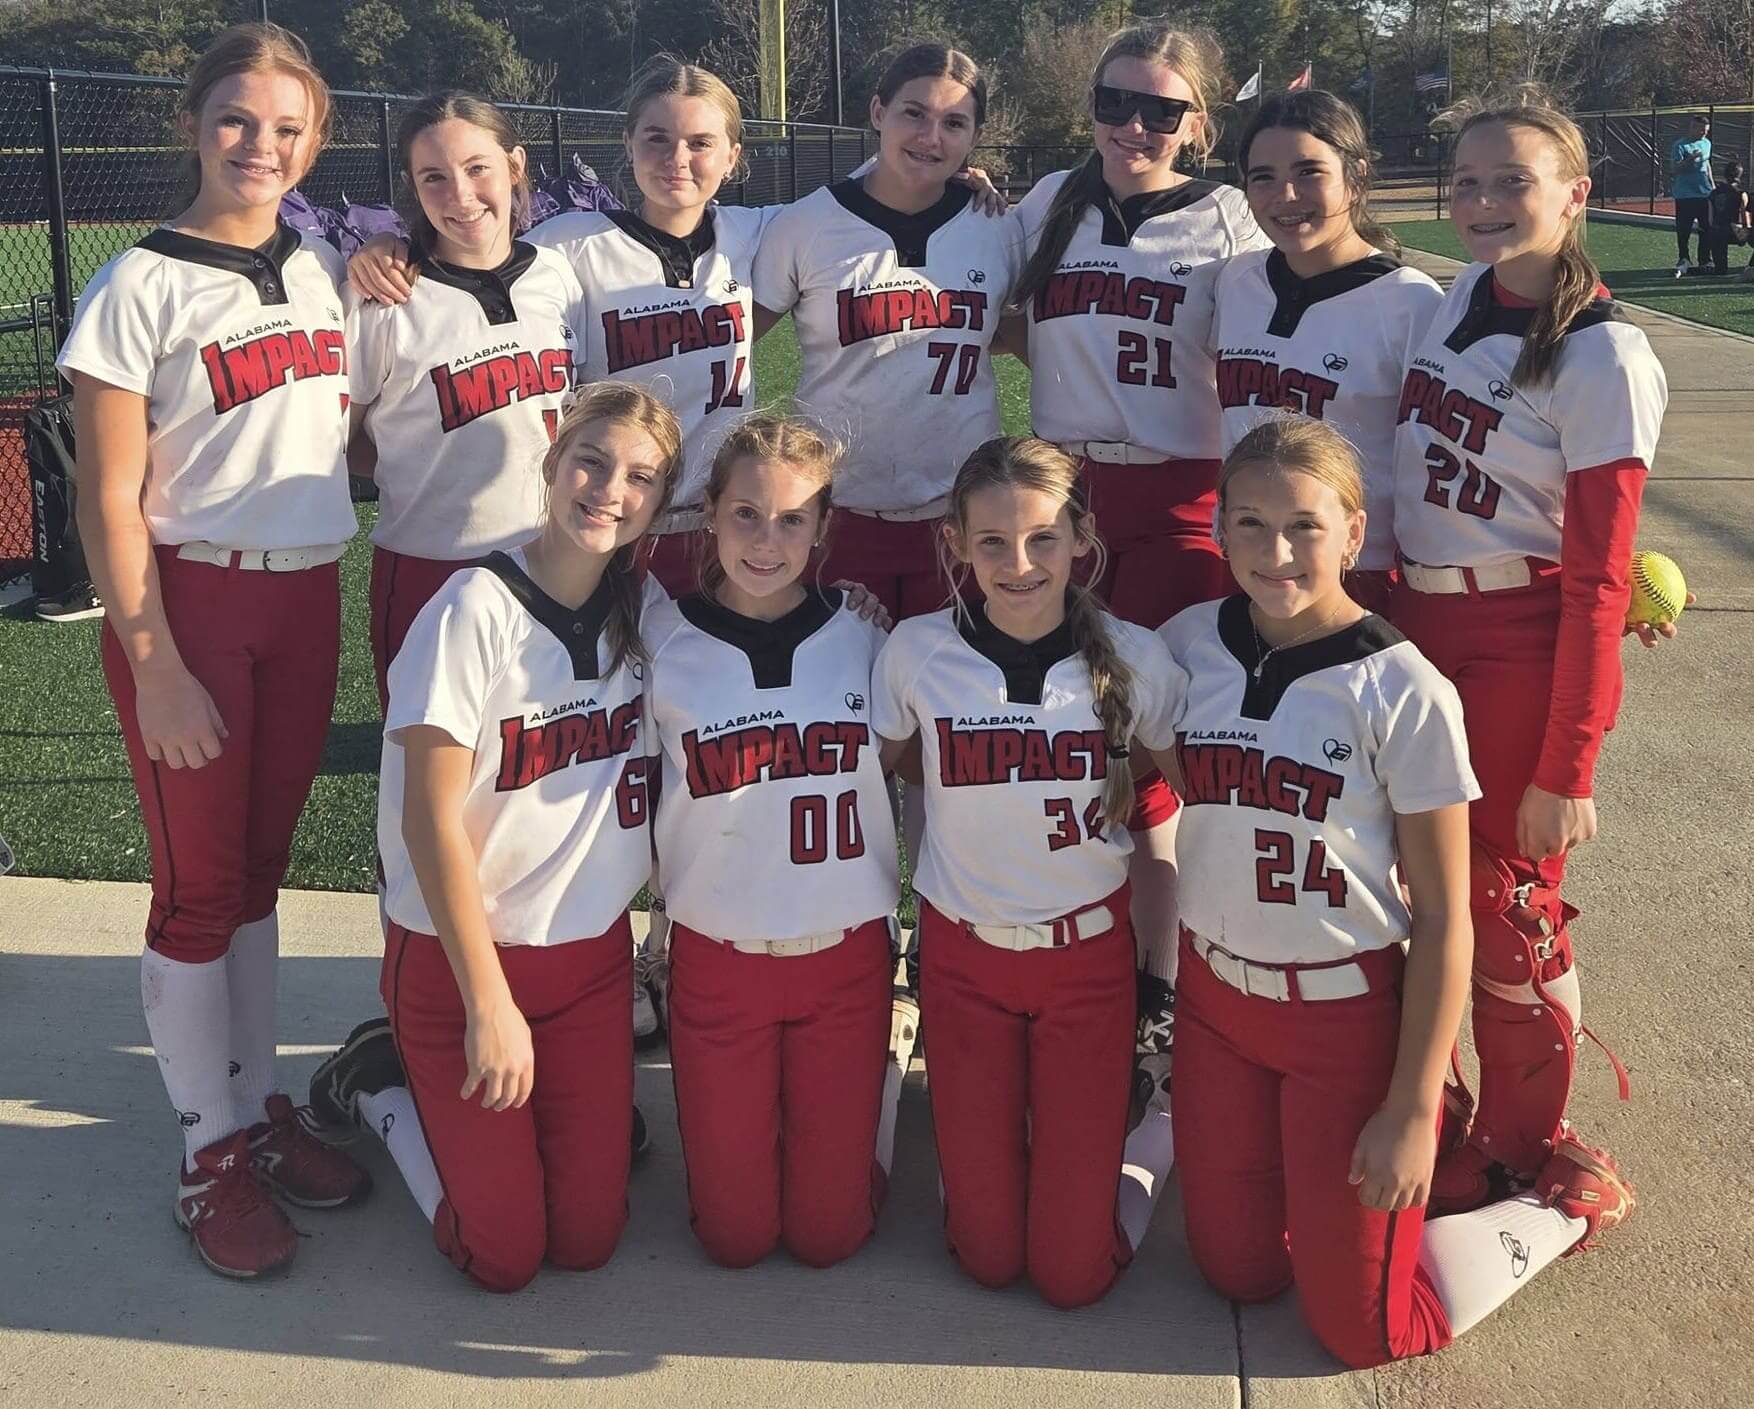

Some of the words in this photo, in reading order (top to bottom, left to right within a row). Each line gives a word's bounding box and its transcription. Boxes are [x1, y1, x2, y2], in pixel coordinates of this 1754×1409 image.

[623, 299, 691, 315] ALABAMA
[860, 279, 921, 292] ALABAMA
[225, 318, 293, 345] ALABAMA
[601, 301, 745, 375] IMPACT
[836, 288, 988, 347] IMPACT
[454, 341, 520, 367] ALABAMA
[928, 342, 981, 395] 70
[1117, 330, 1177, 389] 21
[1424, 443, 1502, 520] 20
[35, 480, 49, 563] EASTON
[530, 698, 597, 722] ALABAMA
[702, 710, 785, 735] ALABAMA
[957, 715, 1036, 726] ALABAMA
[1188, 730, 1258, 743] ALABAMA
[495, 694, 643, 793] IMPAC
[681, 721, 869, 799] IMPACT
[790, 789, 865, 865] 00
[1255, 828, 1348, 908] 24
